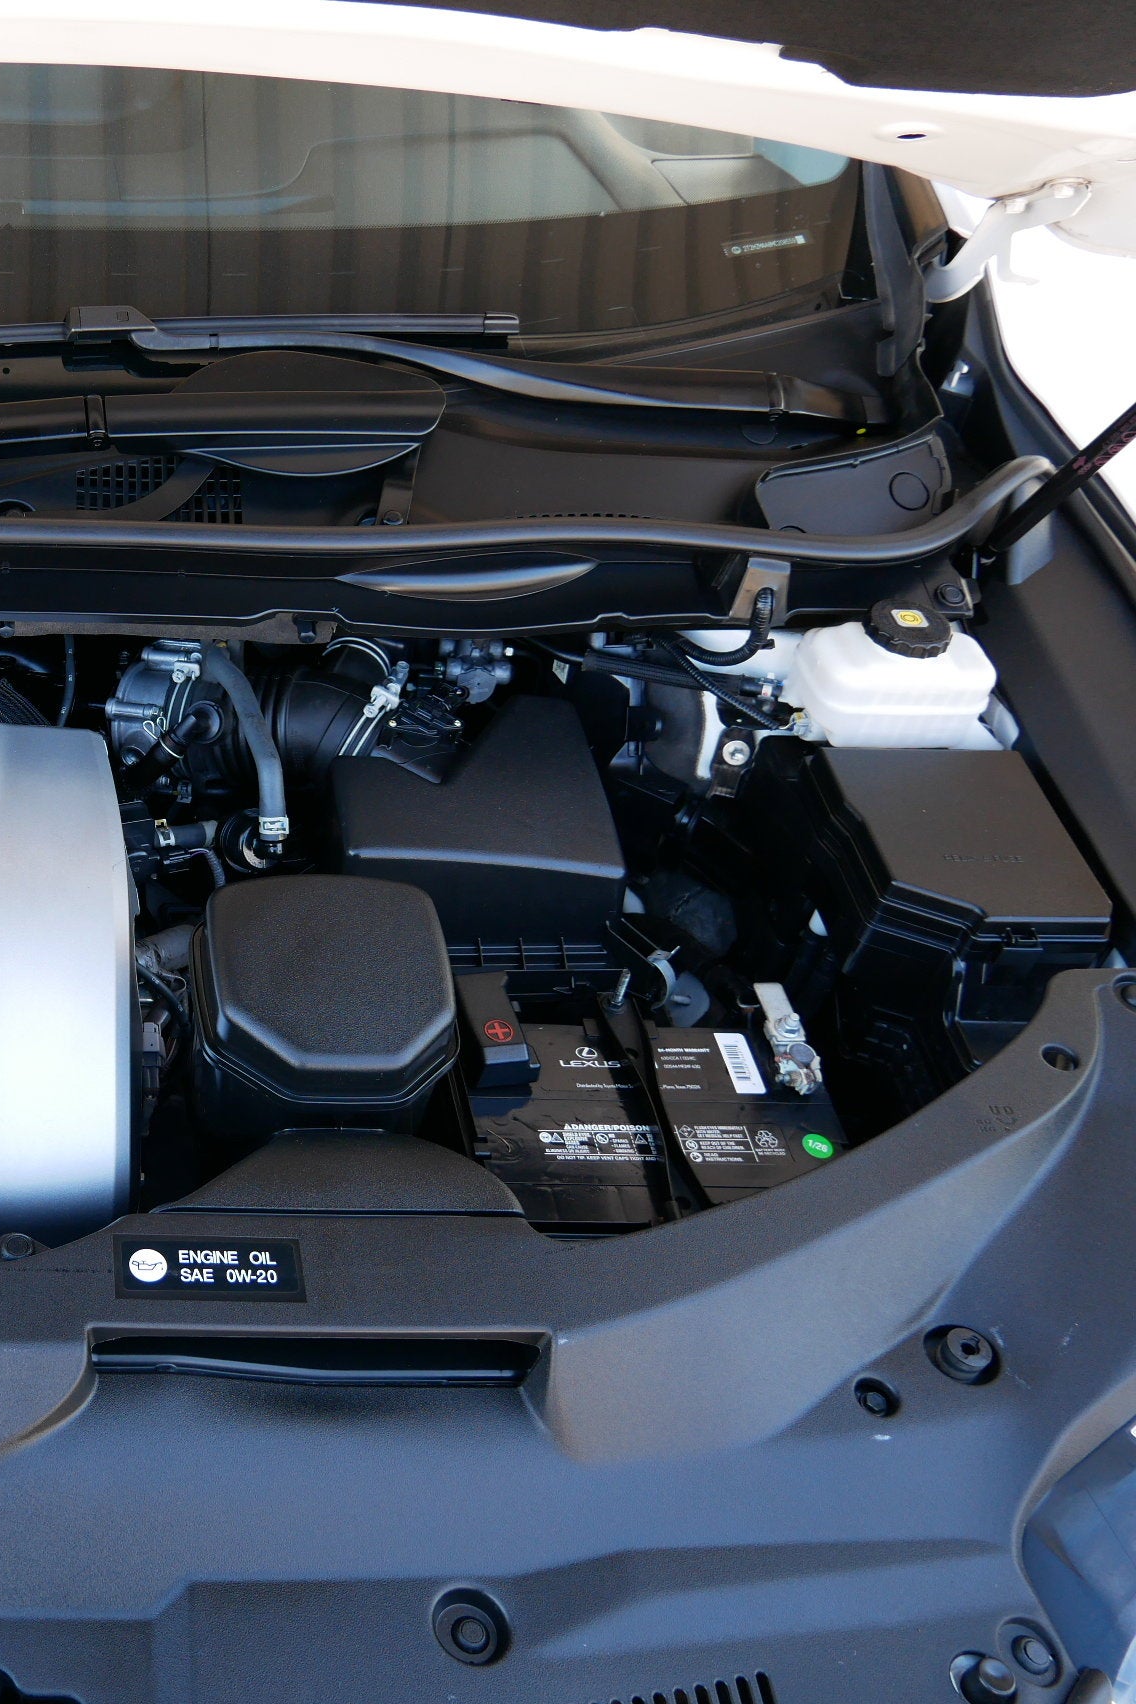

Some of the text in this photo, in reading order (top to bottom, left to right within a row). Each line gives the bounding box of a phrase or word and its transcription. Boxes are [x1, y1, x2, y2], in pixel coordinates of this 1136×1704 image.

[559, 1059, 621, 1068] LEXUS
[571, 1123, 650, 1132] DANGER/POISON
[807, 1140, 828, 1152] 1/26
[178, 1250, 277, 1265] ENGINE OIL
[180, 1268, 278, 1283] SAE 0W-20
